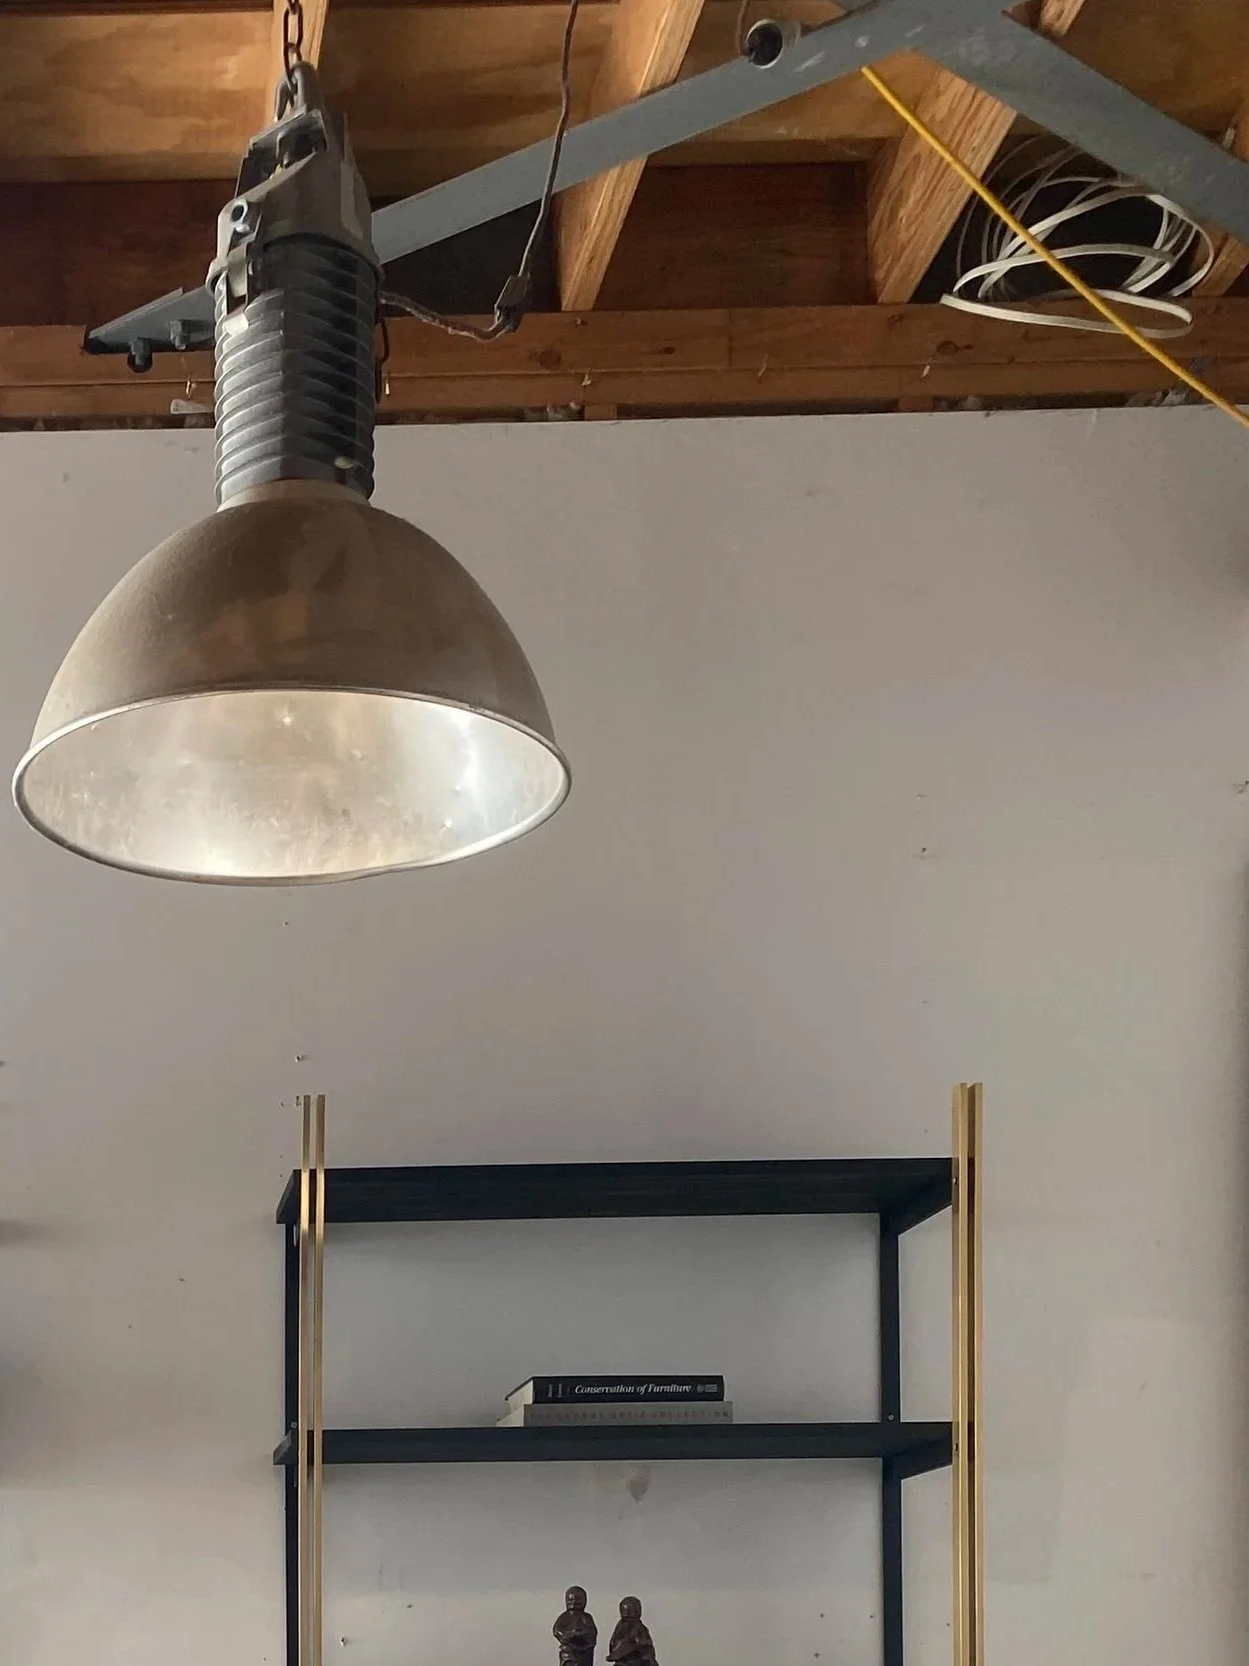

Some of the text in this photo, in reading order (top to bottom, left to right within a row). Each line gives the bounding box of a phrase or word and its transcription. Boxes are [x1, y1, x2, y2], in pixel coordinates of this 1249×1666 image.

[574, 1383, 635, 1395] Conservation
[636, 1383, 649, 1397] of
[648, 1383, 692, 1394] Furniture
